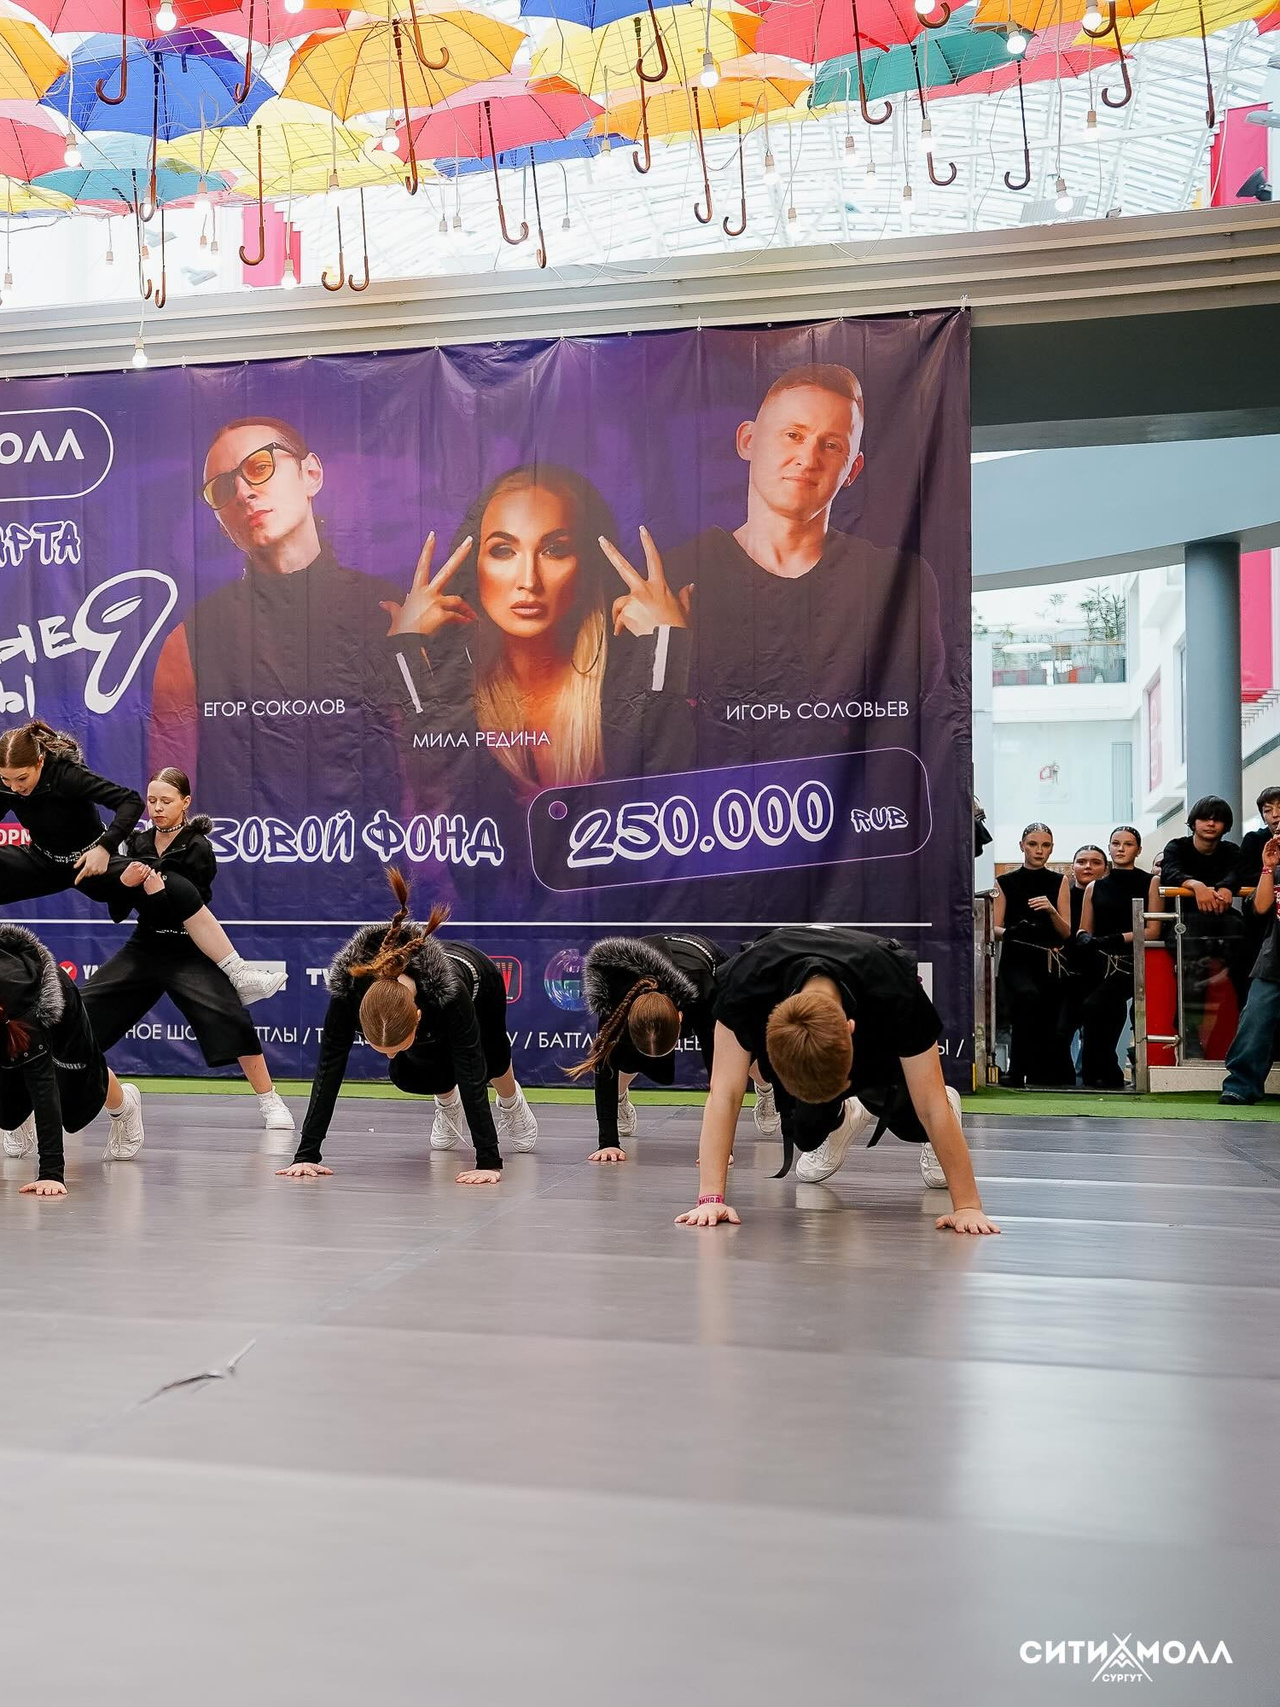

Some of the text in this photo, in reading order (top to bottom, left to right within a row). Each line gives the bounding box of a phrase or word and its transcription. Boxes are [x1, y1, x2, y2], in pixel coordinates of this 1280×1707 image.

[203, 699, 346, 717] ЕГОР СОКОЛОВ
[725, 701, 910, 721] ИГОРЬ СОЛОВЬЕВ
[412, 731, 551, 749] МИЛА РЕДИНА
[567, 780, 910, 869] 250.000 RUB
[211, 809, 505, 867] ЗОВОЙ ФОНД
[539, 1032, 594, 1049] БАТТЛ
